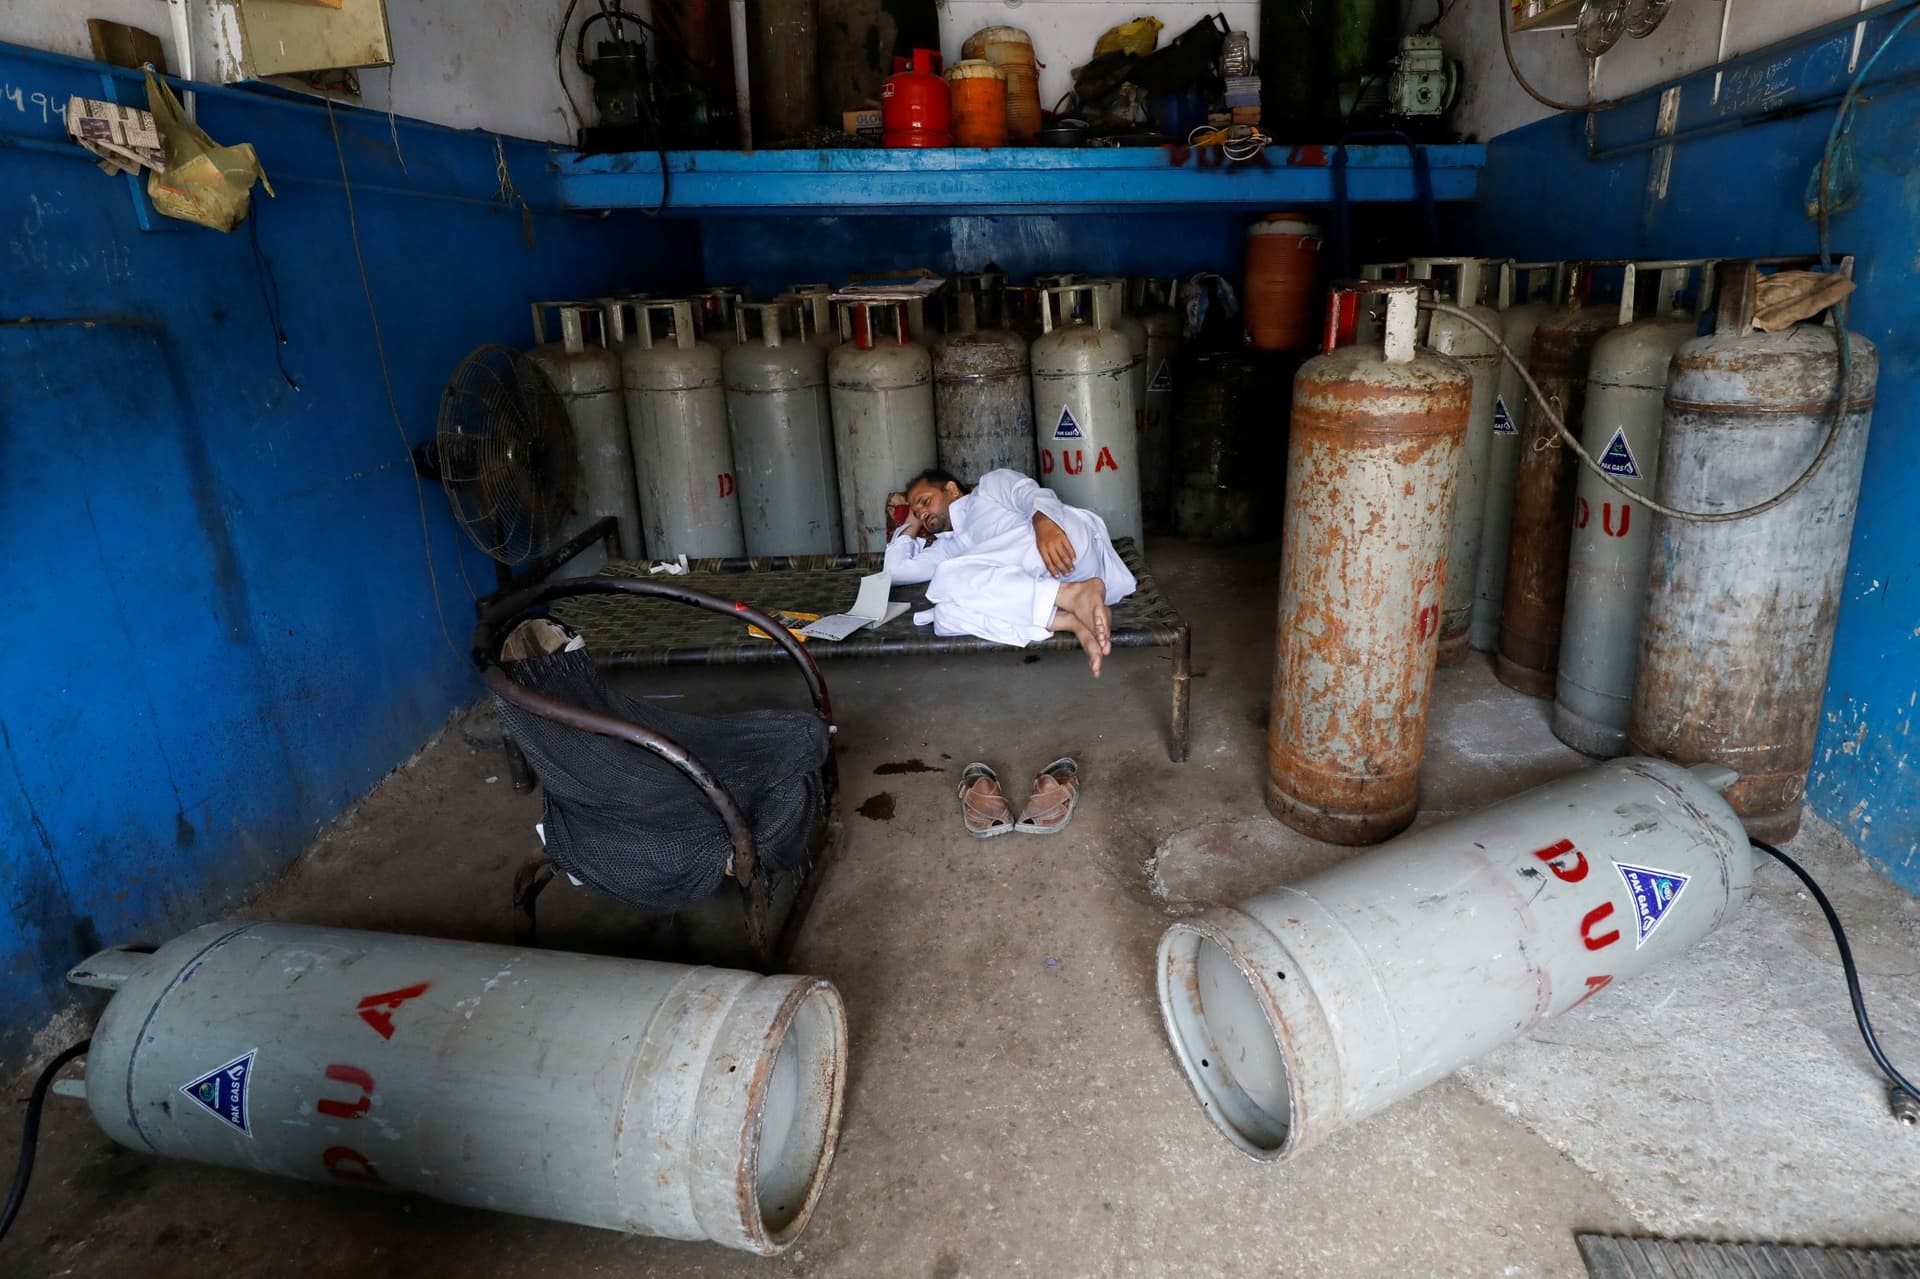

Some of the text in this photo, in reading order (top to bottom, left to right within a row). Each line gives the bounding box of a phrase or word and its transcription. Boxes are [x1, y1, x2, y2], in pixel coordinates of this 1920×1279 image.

[1041, 447, 1118, 475] DUA
[1611, 464, 1625, 472] GAS
[1628, 872, 1650, 917] PAK GAS
[231, 1081, 241, 1124] PAK GAS
